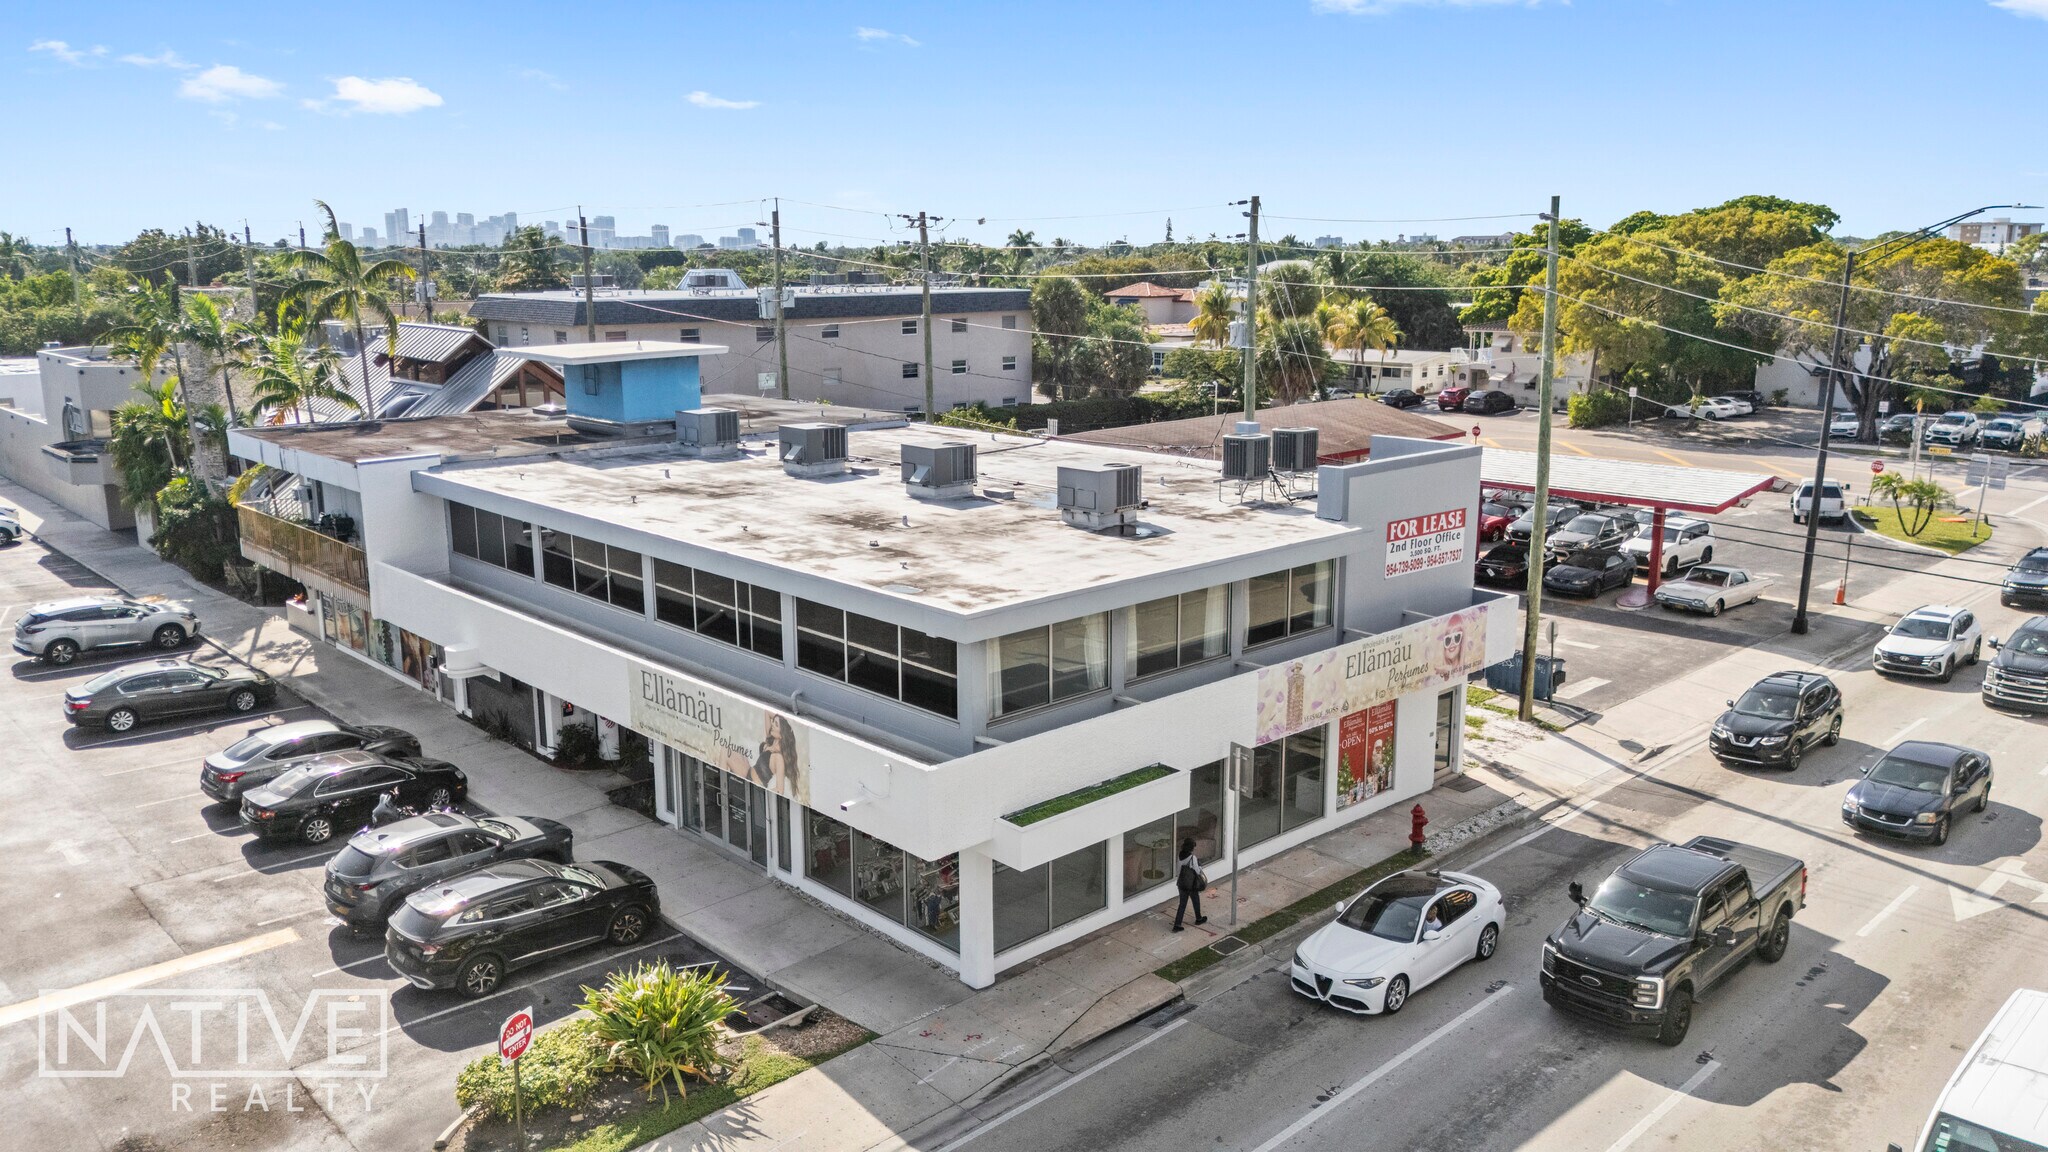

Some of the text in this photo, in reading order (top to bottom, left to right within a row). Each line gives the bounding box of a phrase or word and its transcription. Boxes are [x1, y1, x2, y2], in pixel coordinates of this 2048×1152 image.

[1390, 511, 1462, 541] FOR LEASE
[1389, 531, 1461, 554] 2nd Floor Office
[1345, 641, 1412, 680] Ellämäu
[1387, 662, 1429, 689] Perfumes
[641, 669, 723, 730] Ellämäu
[713, 729, 754, 760] Perfumes
[1341, 733, 1362, 750] OPEN
[506, 1018, 527, 1039] DO NOT
[508, 1037, 527, 1055] ENTER
